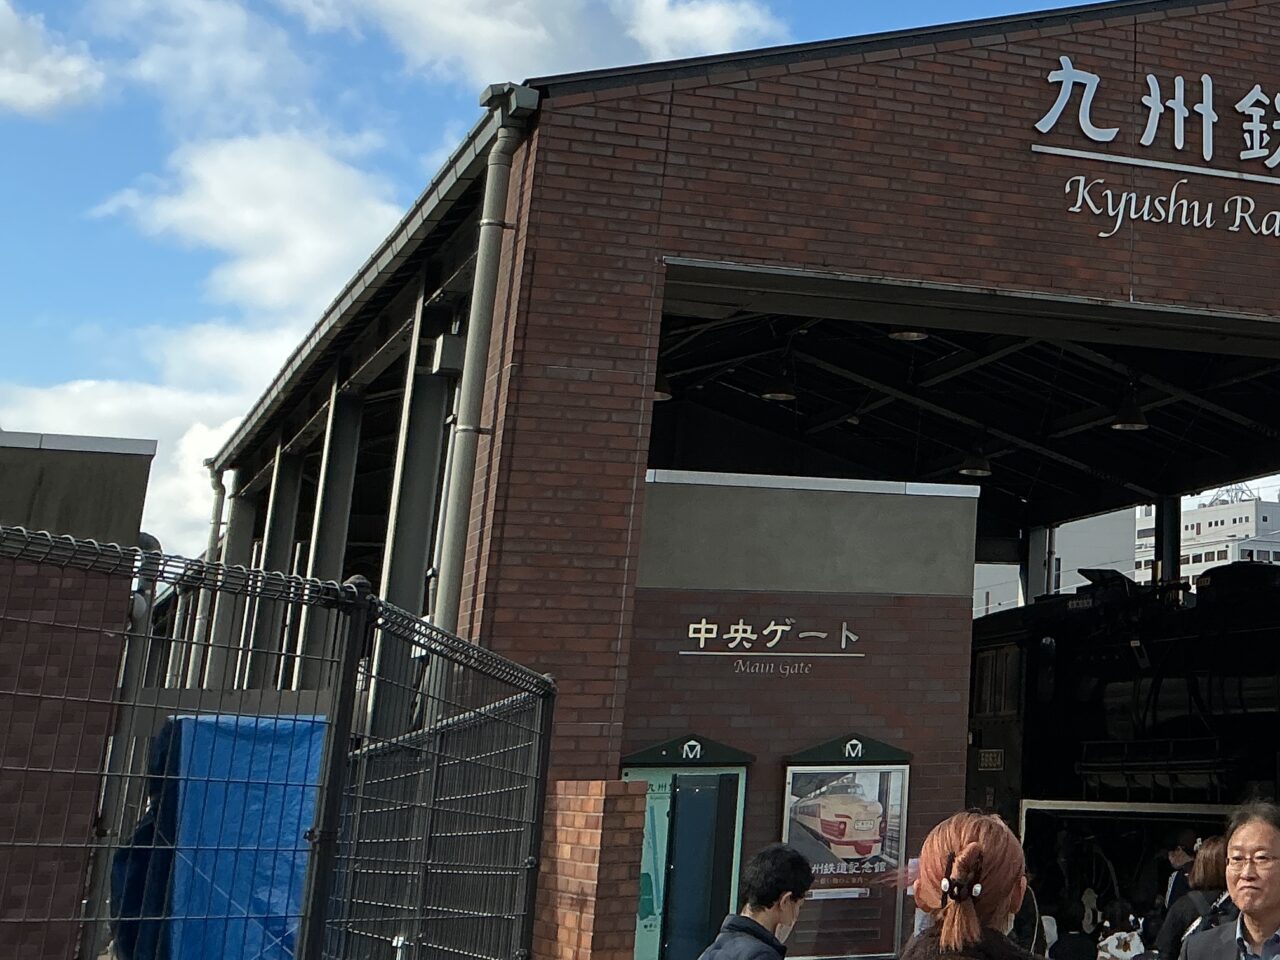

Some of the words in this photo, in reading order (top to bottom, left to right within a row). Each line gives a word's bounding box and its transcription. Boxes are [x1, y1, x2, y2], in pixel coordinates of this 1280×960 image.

[1064, 174, 1215, 240] Kyushu
[688, 618, 860, 650] 中央ゲート
[733, 659, 775, 675] Main
[779, 661, 813, 678] Gate
[812, 862, 887, 874] 州鉄道記念館
